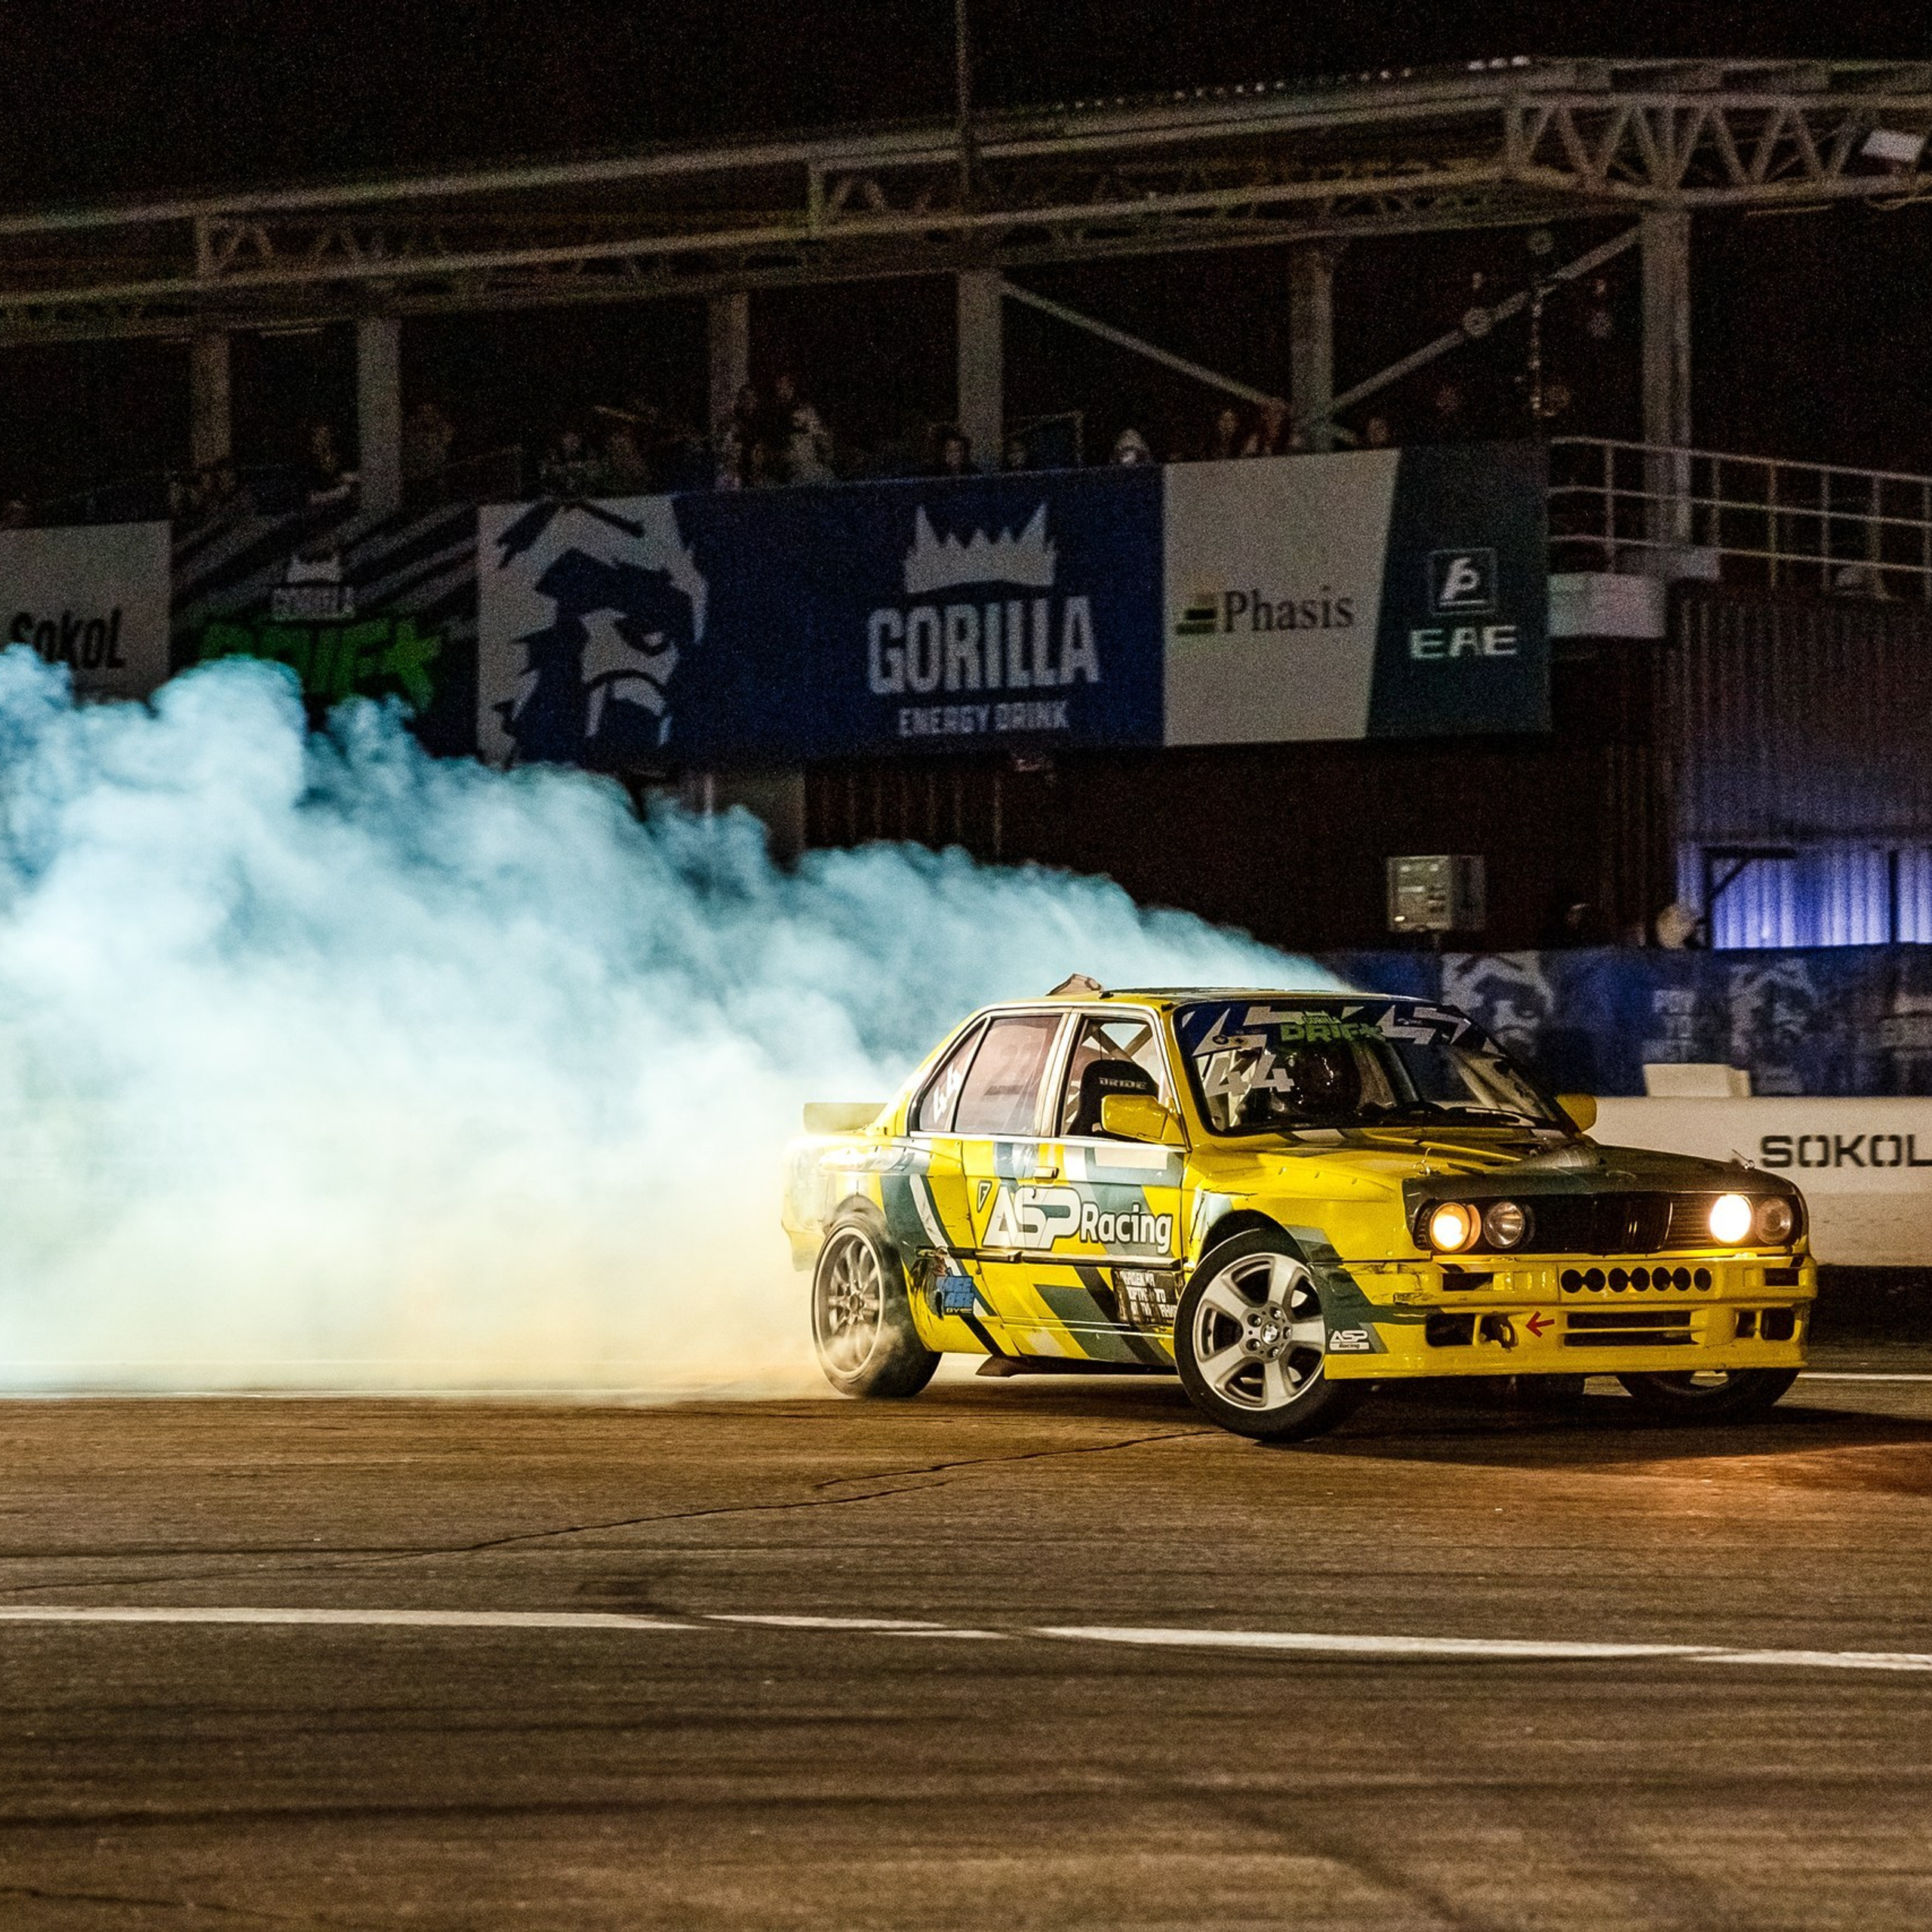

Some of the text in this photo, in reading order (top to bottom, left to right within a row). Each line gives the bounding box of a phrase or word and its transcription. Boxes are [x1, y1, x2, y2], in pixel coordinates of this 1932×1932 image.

[1223, 584, 1355, 633] Phasis
[868, 595, 1100, 695] GORILLA
[1409, 624, 1518, 660] EAE
[898, 700, 1069, 738] ENERGY DRINK
[1761, 1134, 1932, 1168] SOKOL
[983, 1186, 1172, 1254] ASP Racing
[1330, 1330, 1368, 1343] ASP
